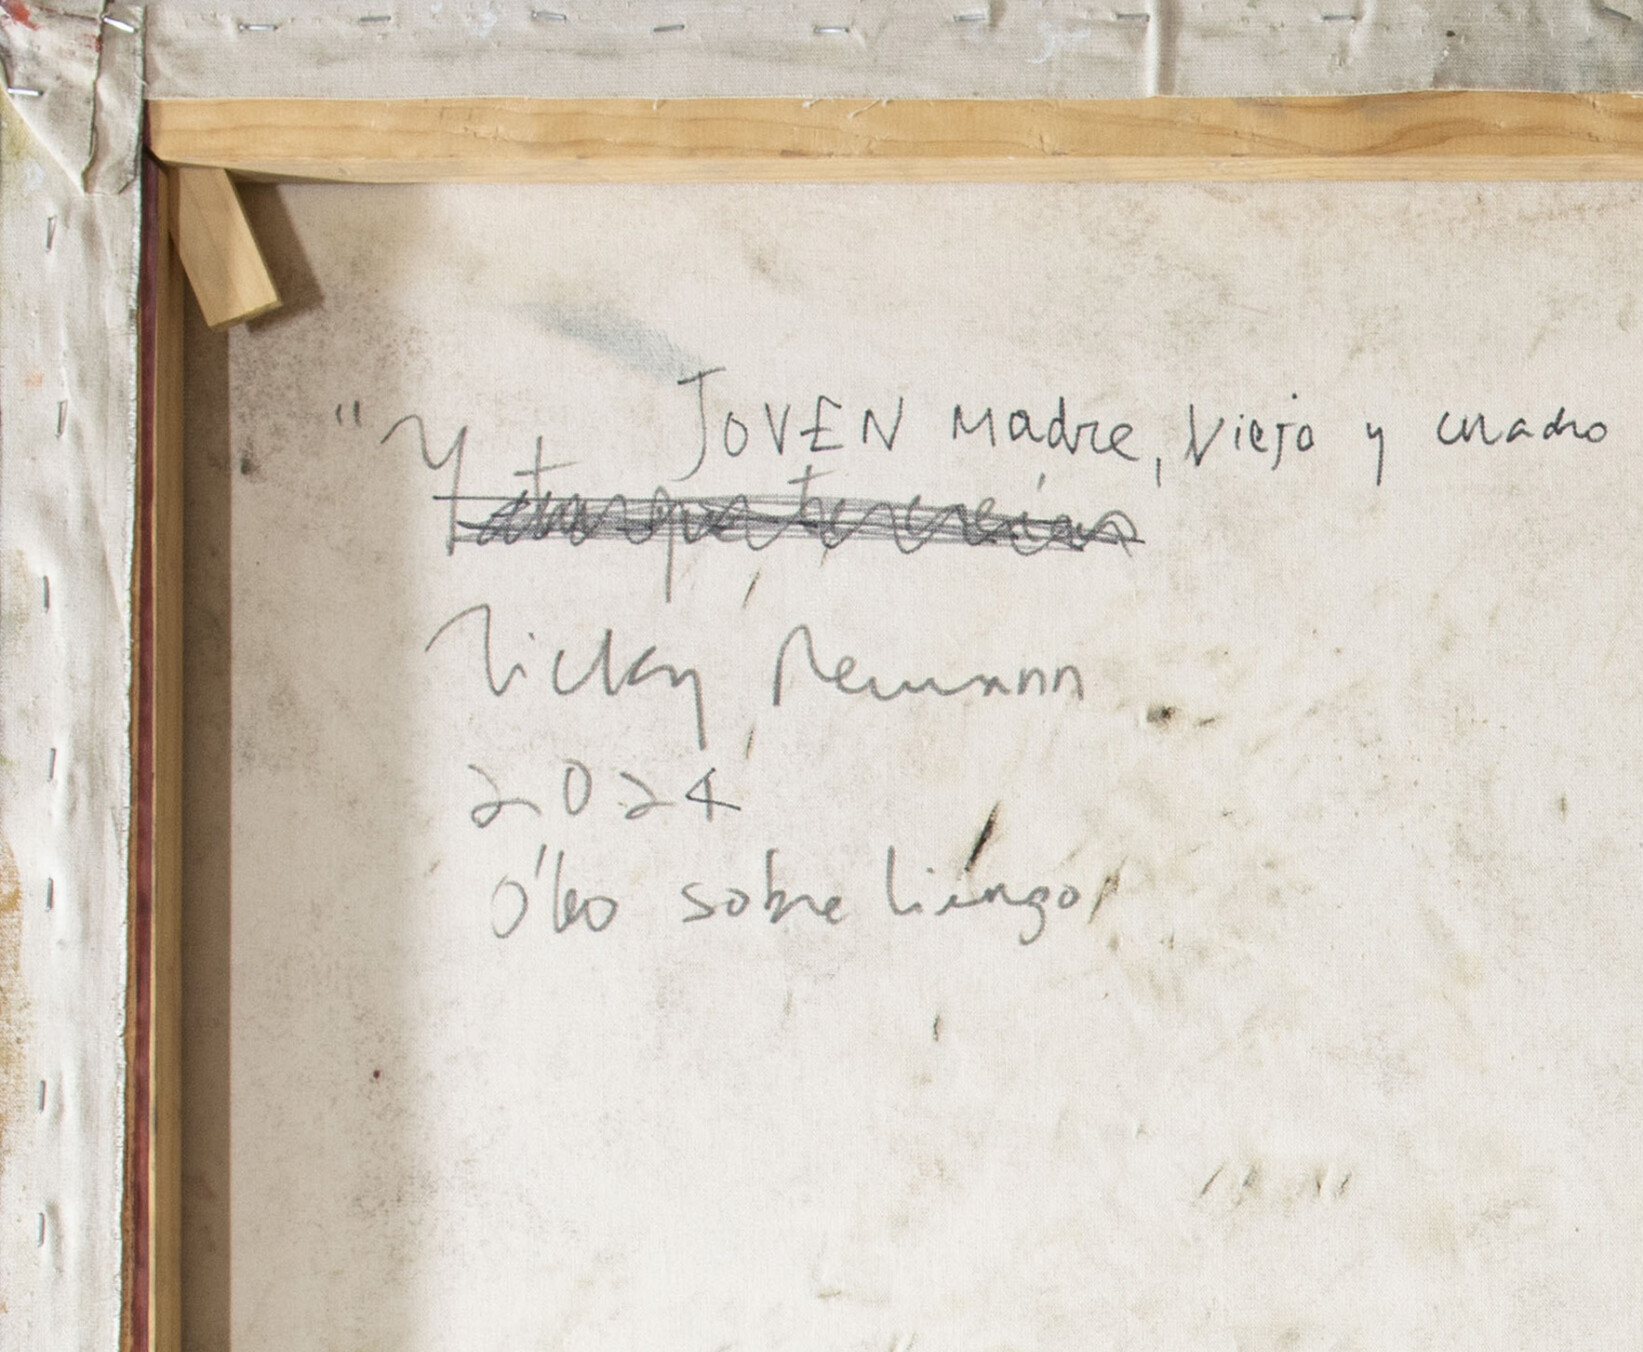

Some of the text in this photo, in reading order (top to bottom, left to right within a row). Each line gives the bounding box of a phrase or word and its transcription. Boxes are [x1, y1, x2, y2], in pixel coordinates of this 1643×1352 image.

[678, 370, 905, 481] JOVEN
[1365, 416, 1385, 486] y
[470, 763, 742, 828] 2024
[680, 846, 850, 925] sobre
